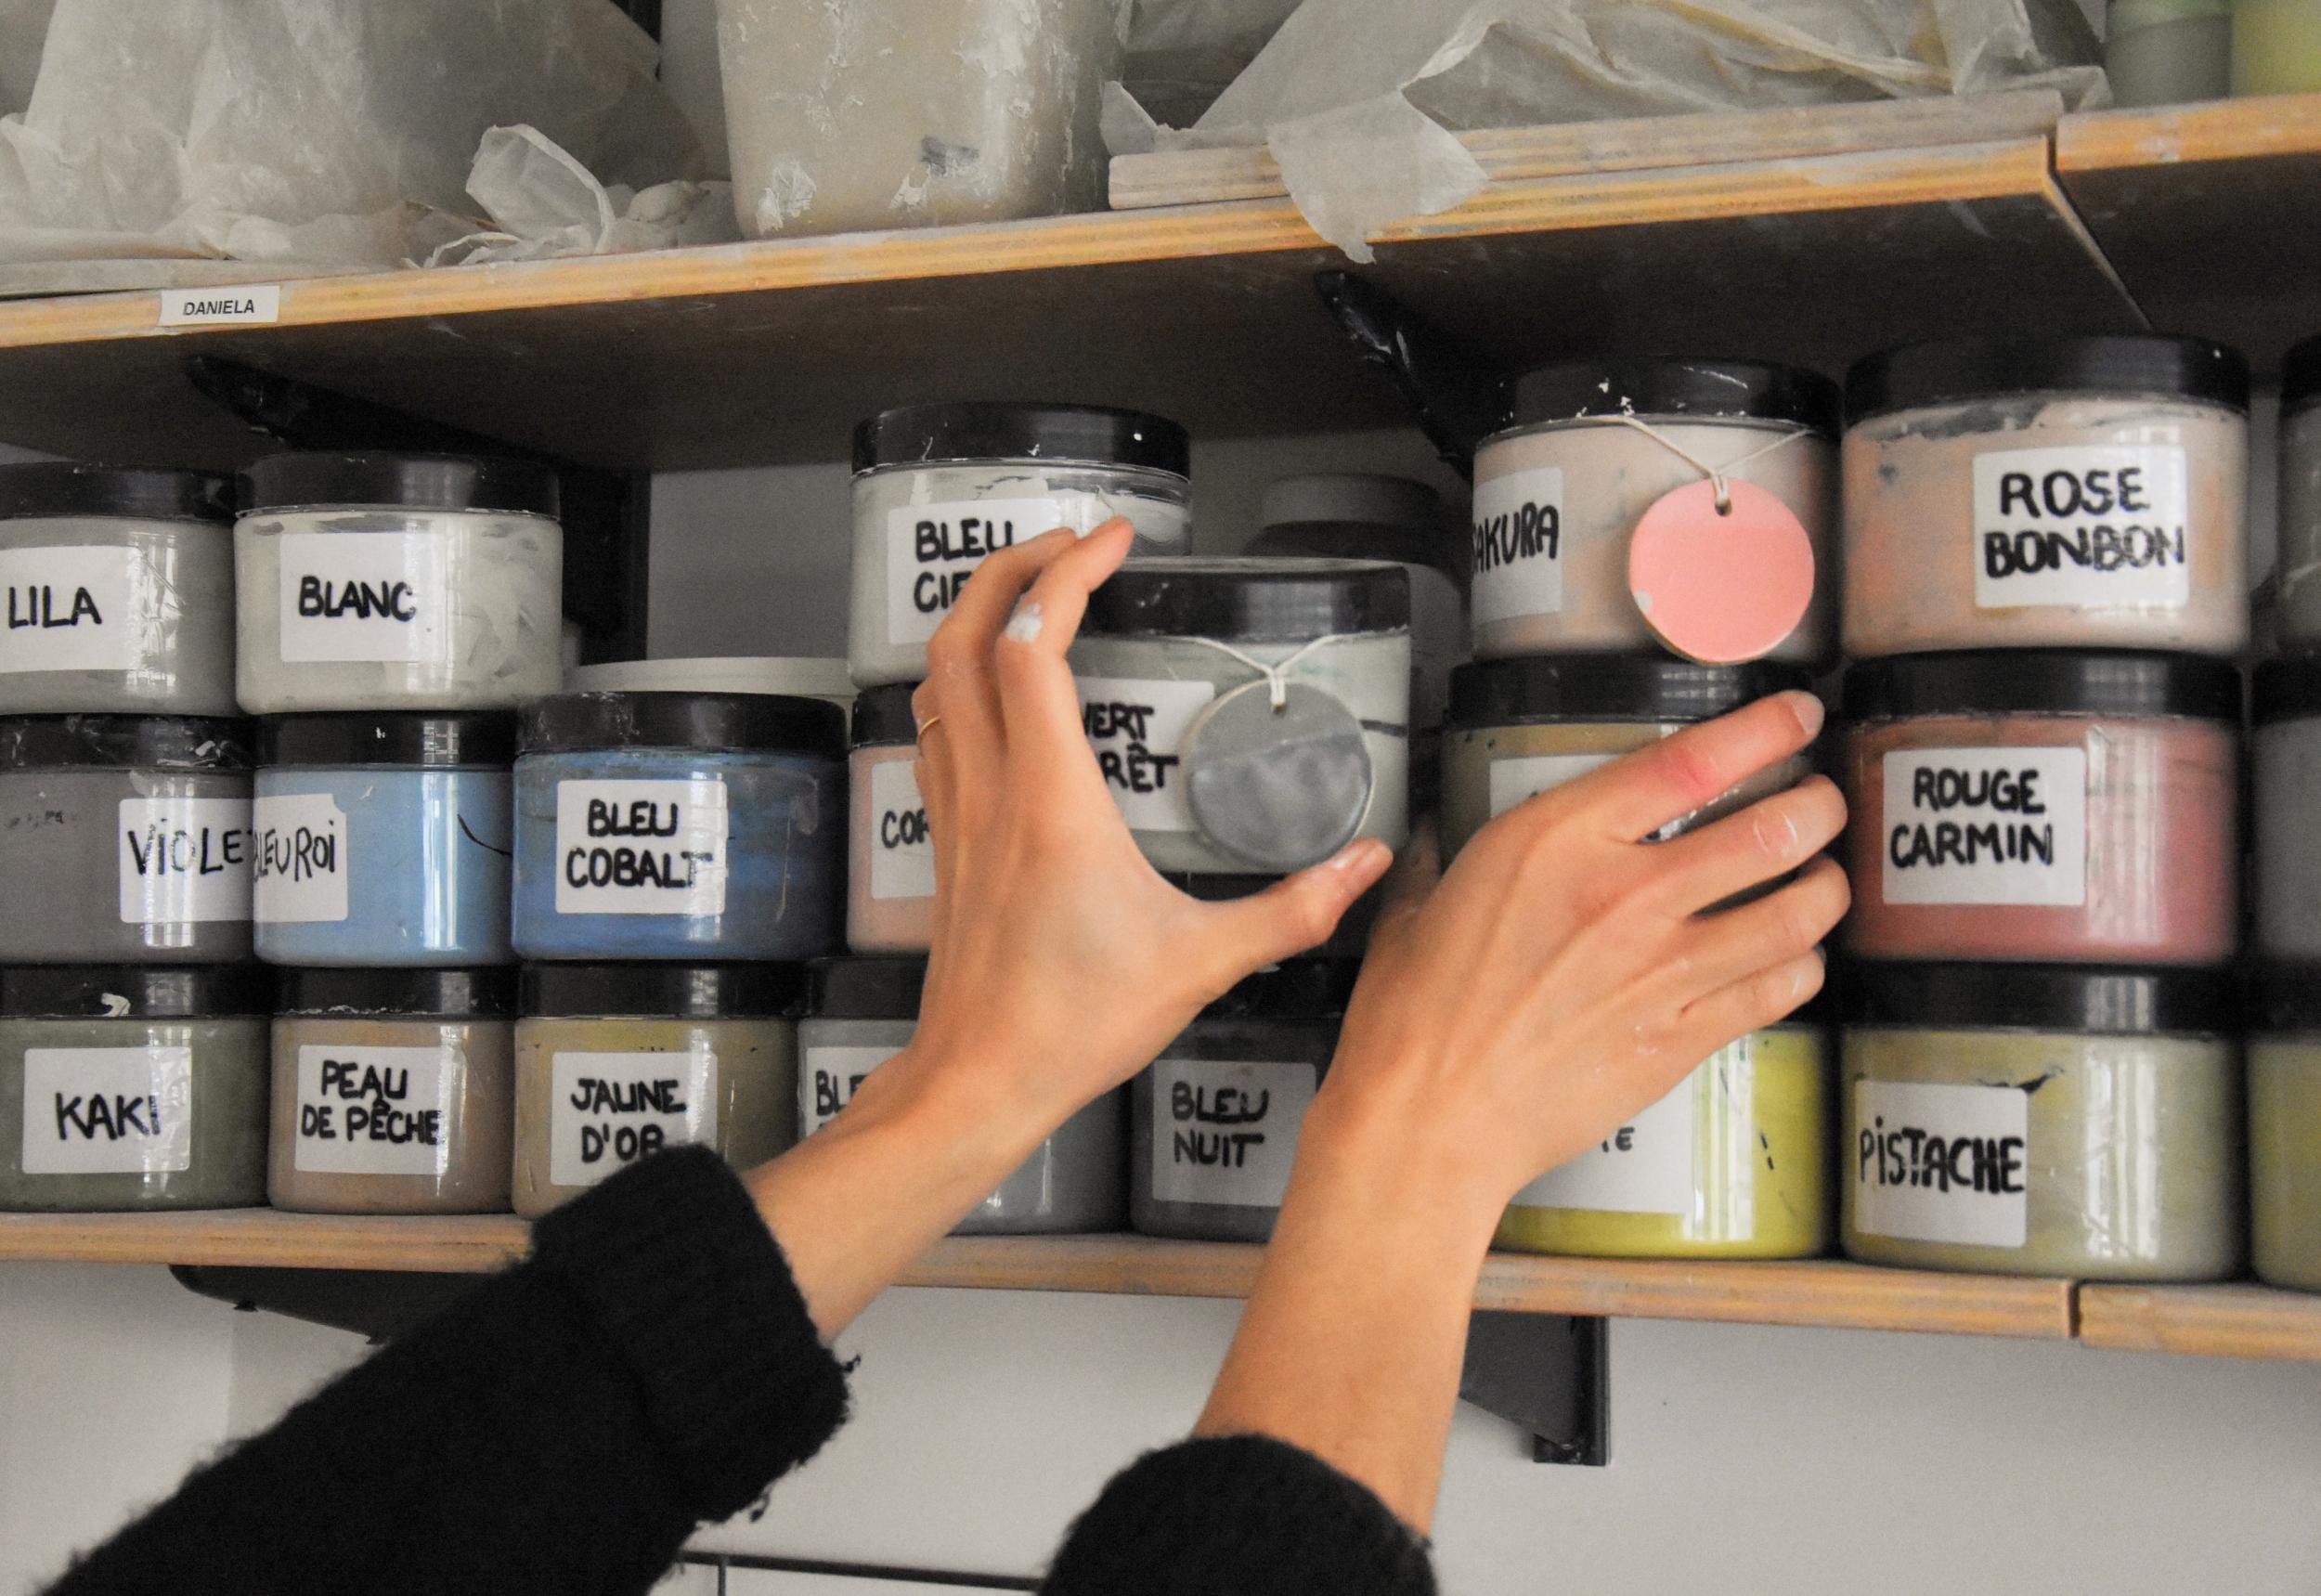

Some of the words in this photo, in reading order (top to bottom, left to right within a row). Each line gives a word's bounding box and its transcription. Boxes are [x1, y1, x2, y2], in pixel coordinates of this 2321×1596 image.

[183, 299, 254, 316] DANIELA
[2000, 467, 2151, 518] ROSE
[915, 518, 1013, 563] BLEU
[1472, 501, 1559, 573] AKURA
[1984, 525, 2185, 579] BONBON
[8, 586, 102, 629] LILA
[299, 575, 417, 622] BLANC
[1099, 743, 1179, 793] RÊT
[1913, 767, 2045, 814] ROUGE
[588, 798, 679, 837] BLEU
[127, 816, 253, 876] ViOLE
[1890, 823, 2053, 867] CARMIN
[565, 847, 713, 889] COBALT
[321, 1059, 408, 1099] PEAU
[570, 1078, 687, 1113] JAUNE
[56, 1092, 161, 1140] KAKI
[302, 1104, 336, 1138] DE
[346, 1099, 444, 1145] PÊCHE
[1172, 1080, 1270, 1123] BLEU
[581, 1122, 665, 1163] D'OR
[1173, 1131, 1265, 1168] NUIT
